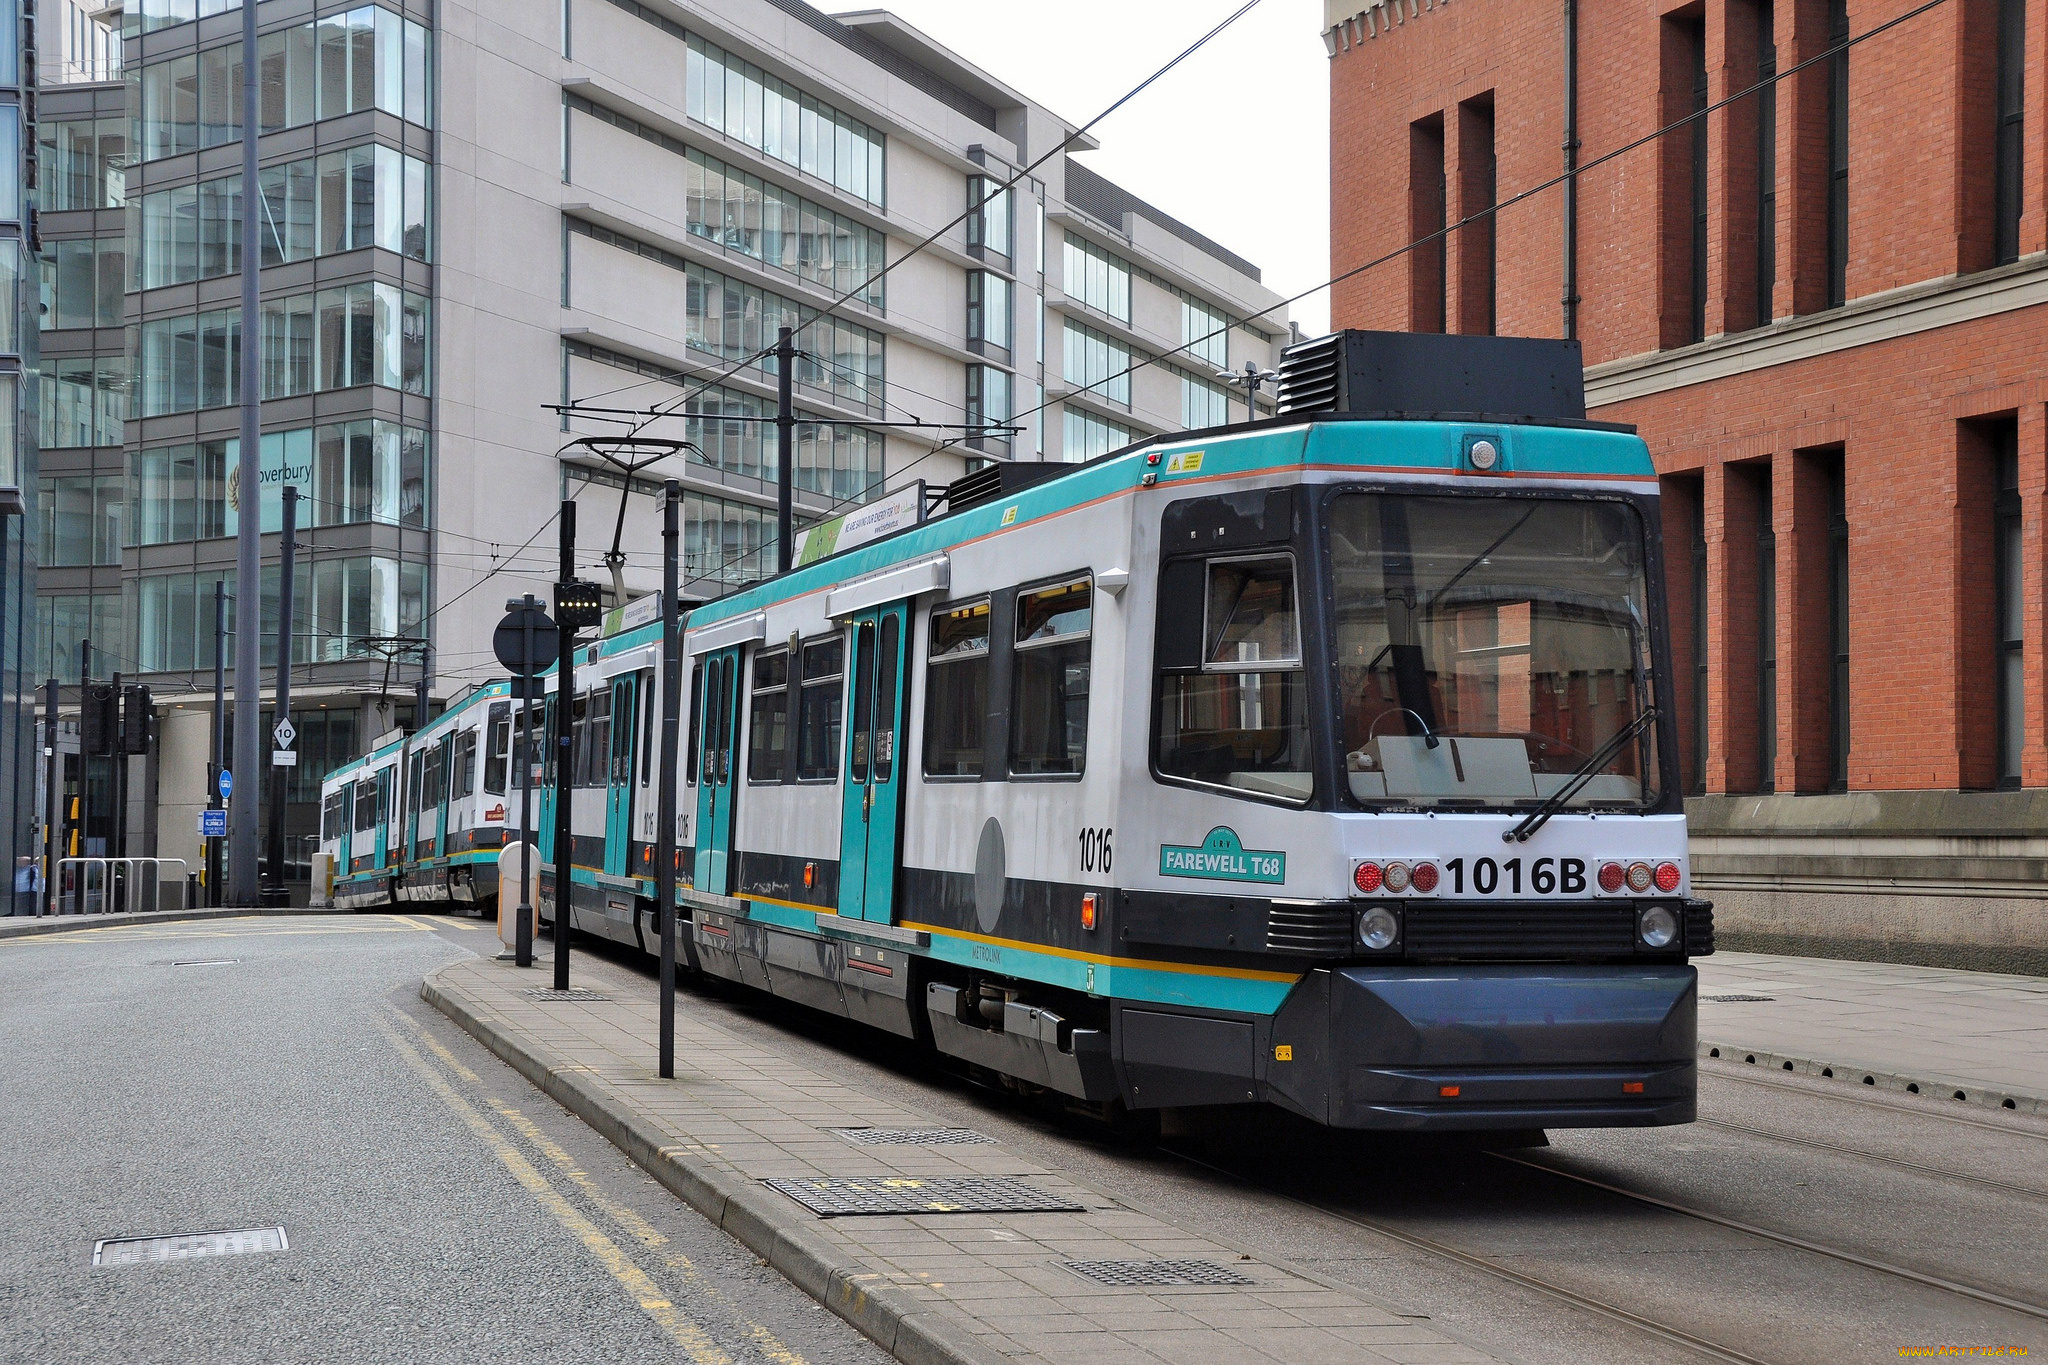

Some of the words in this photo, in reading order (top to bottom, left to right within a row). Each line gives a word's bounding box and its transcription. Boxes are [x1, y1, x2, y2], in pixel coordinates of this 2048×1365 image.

[278, 728, 292, 739] 10
[677, 814, 689, 840] 1016
[1078, 827, 1113, 874] 1016
[1166, 851, 1247, 874] FAREWELL
[1251, 856, 1280, 876] T68
[1445, 857, 1586, 894] 1016B
[972, 945, 1001, 964] METROLINK
